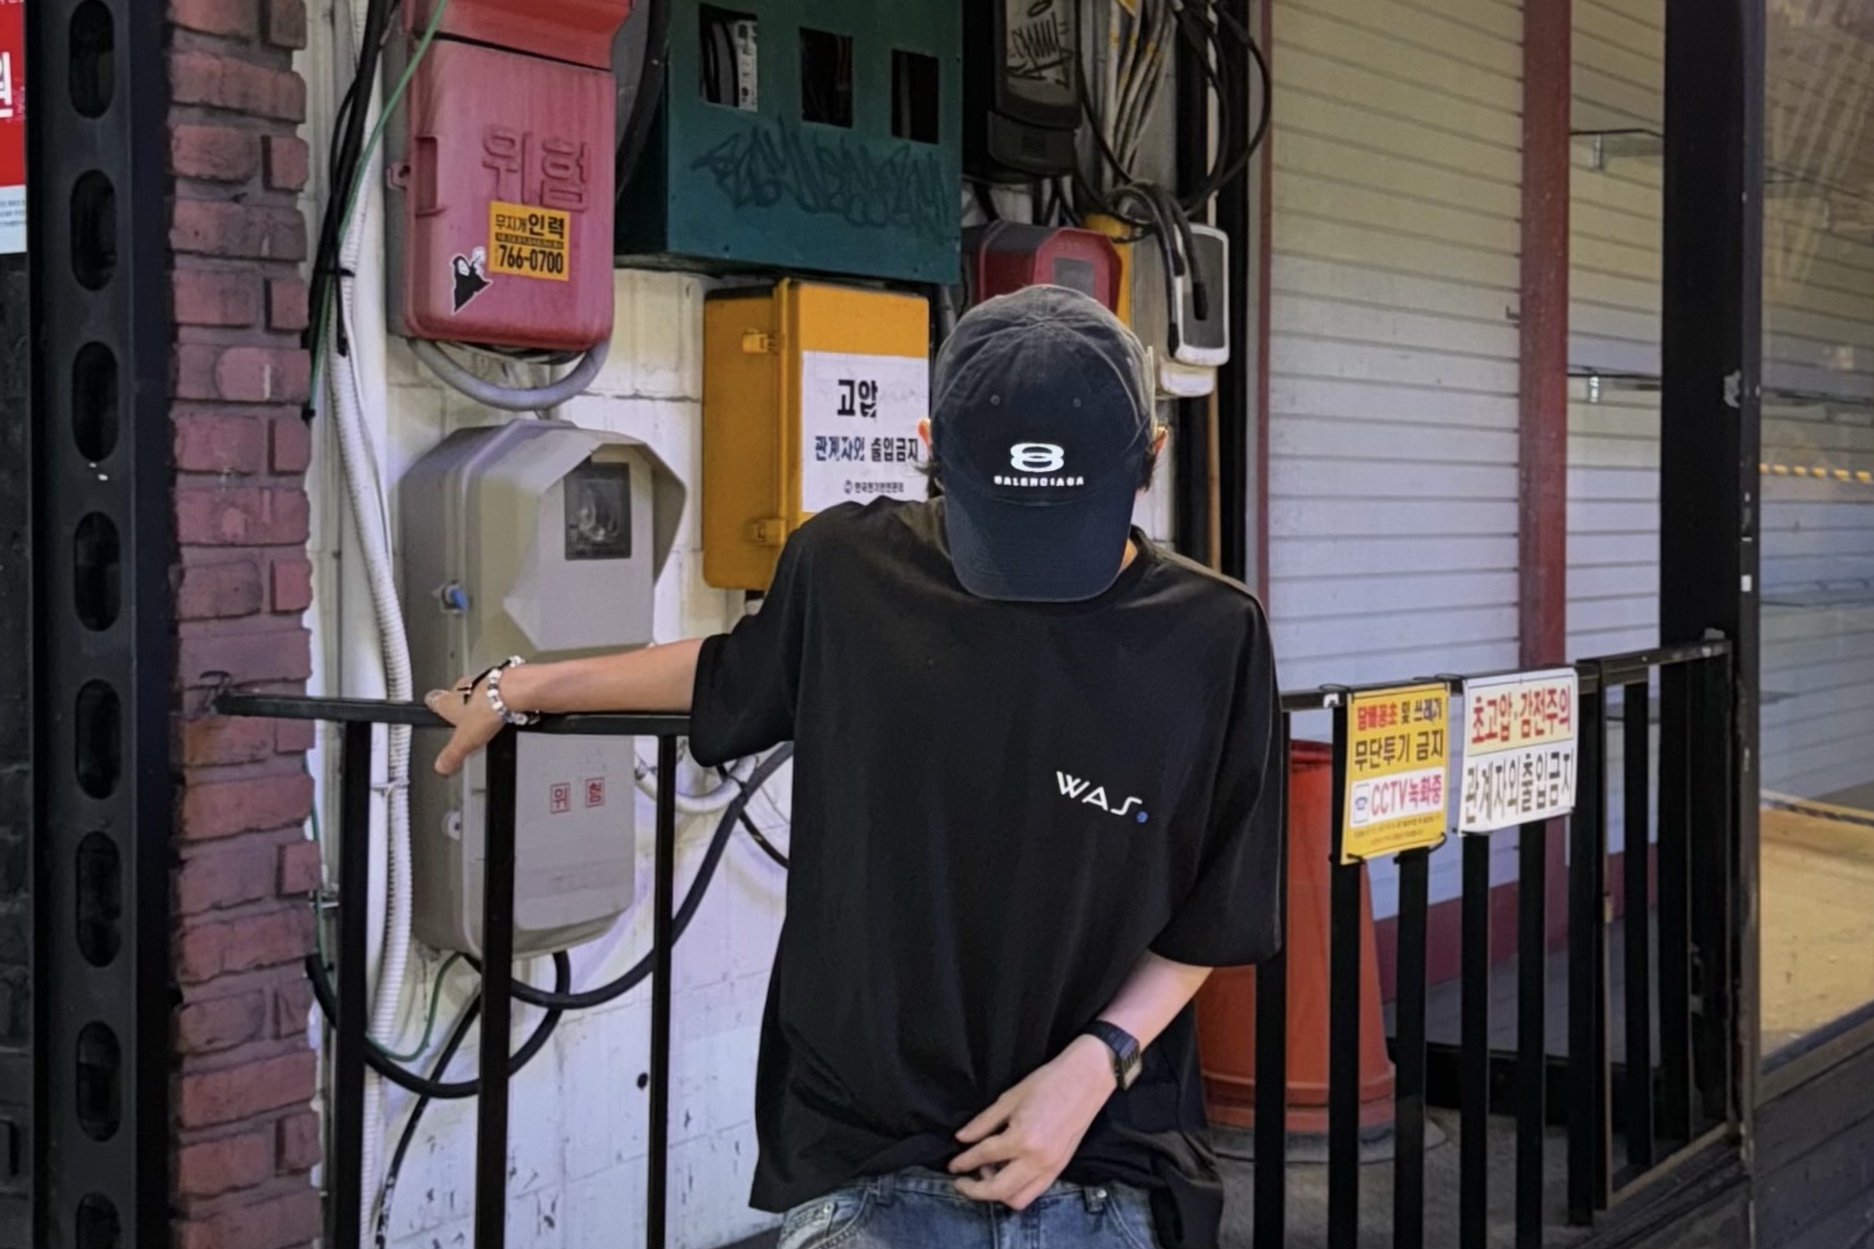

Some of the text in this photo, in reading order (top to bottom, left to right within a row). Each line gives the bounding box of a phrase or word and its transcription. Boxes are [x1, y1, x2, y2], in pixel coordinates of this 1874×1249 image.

[482, 127, 589, 213] 위험
[499, 244, 564, 275] 766-0700
[837, 379, 878, 418] 고압
[1355, 729, 1443, 772] 무단투기 금지
